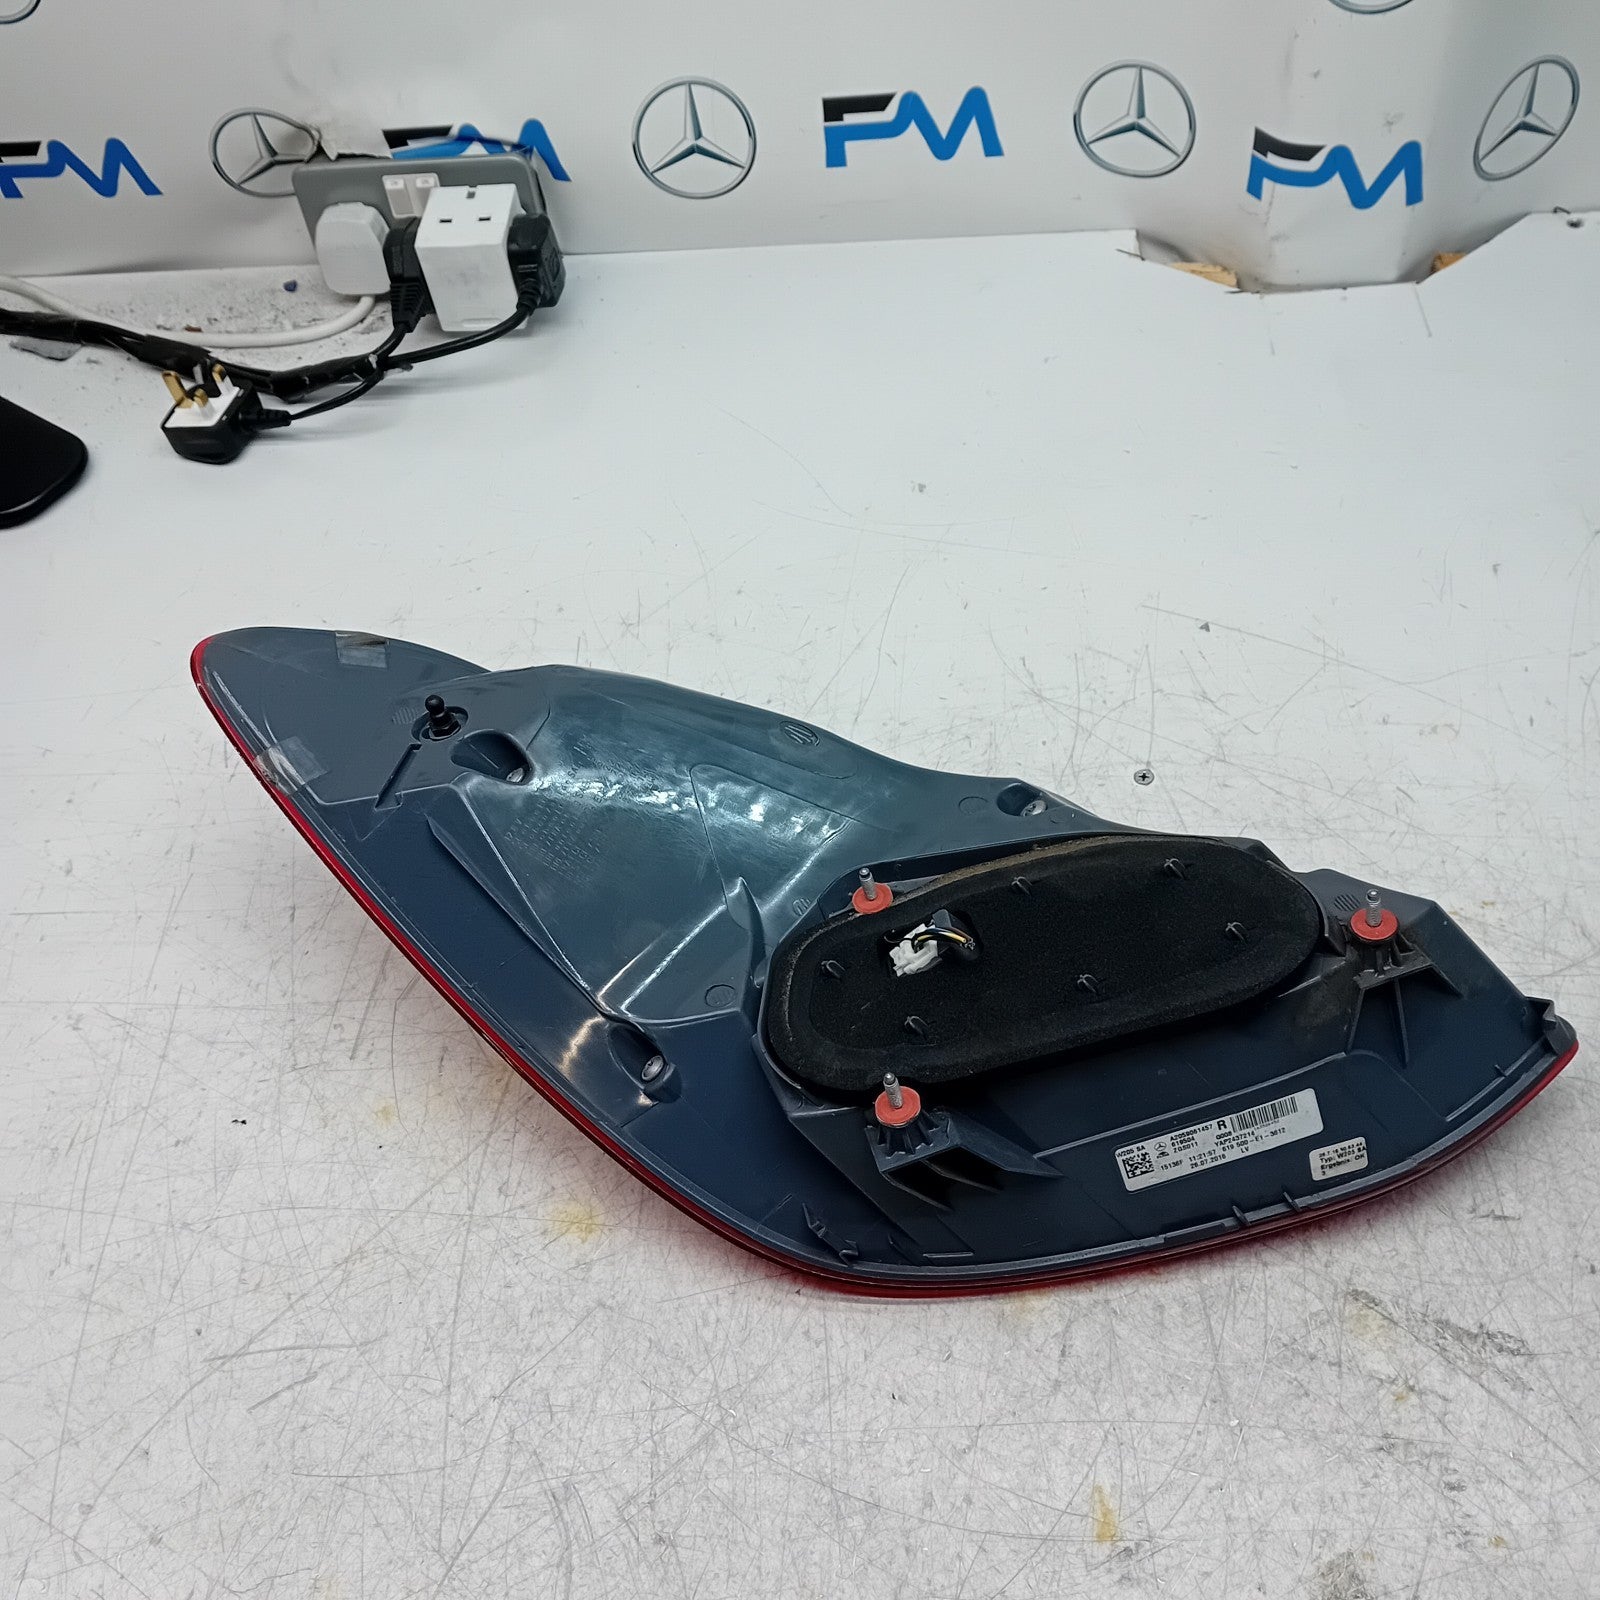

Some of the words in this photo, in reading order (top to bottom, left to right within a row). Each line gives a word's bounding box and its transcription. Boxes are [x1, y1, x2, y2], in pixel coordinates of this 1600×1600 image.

[822, 86, 1004, 168] FM
[1246, 126, 1423, 210] FM
[1216, 1119, 1228, 1131] R
